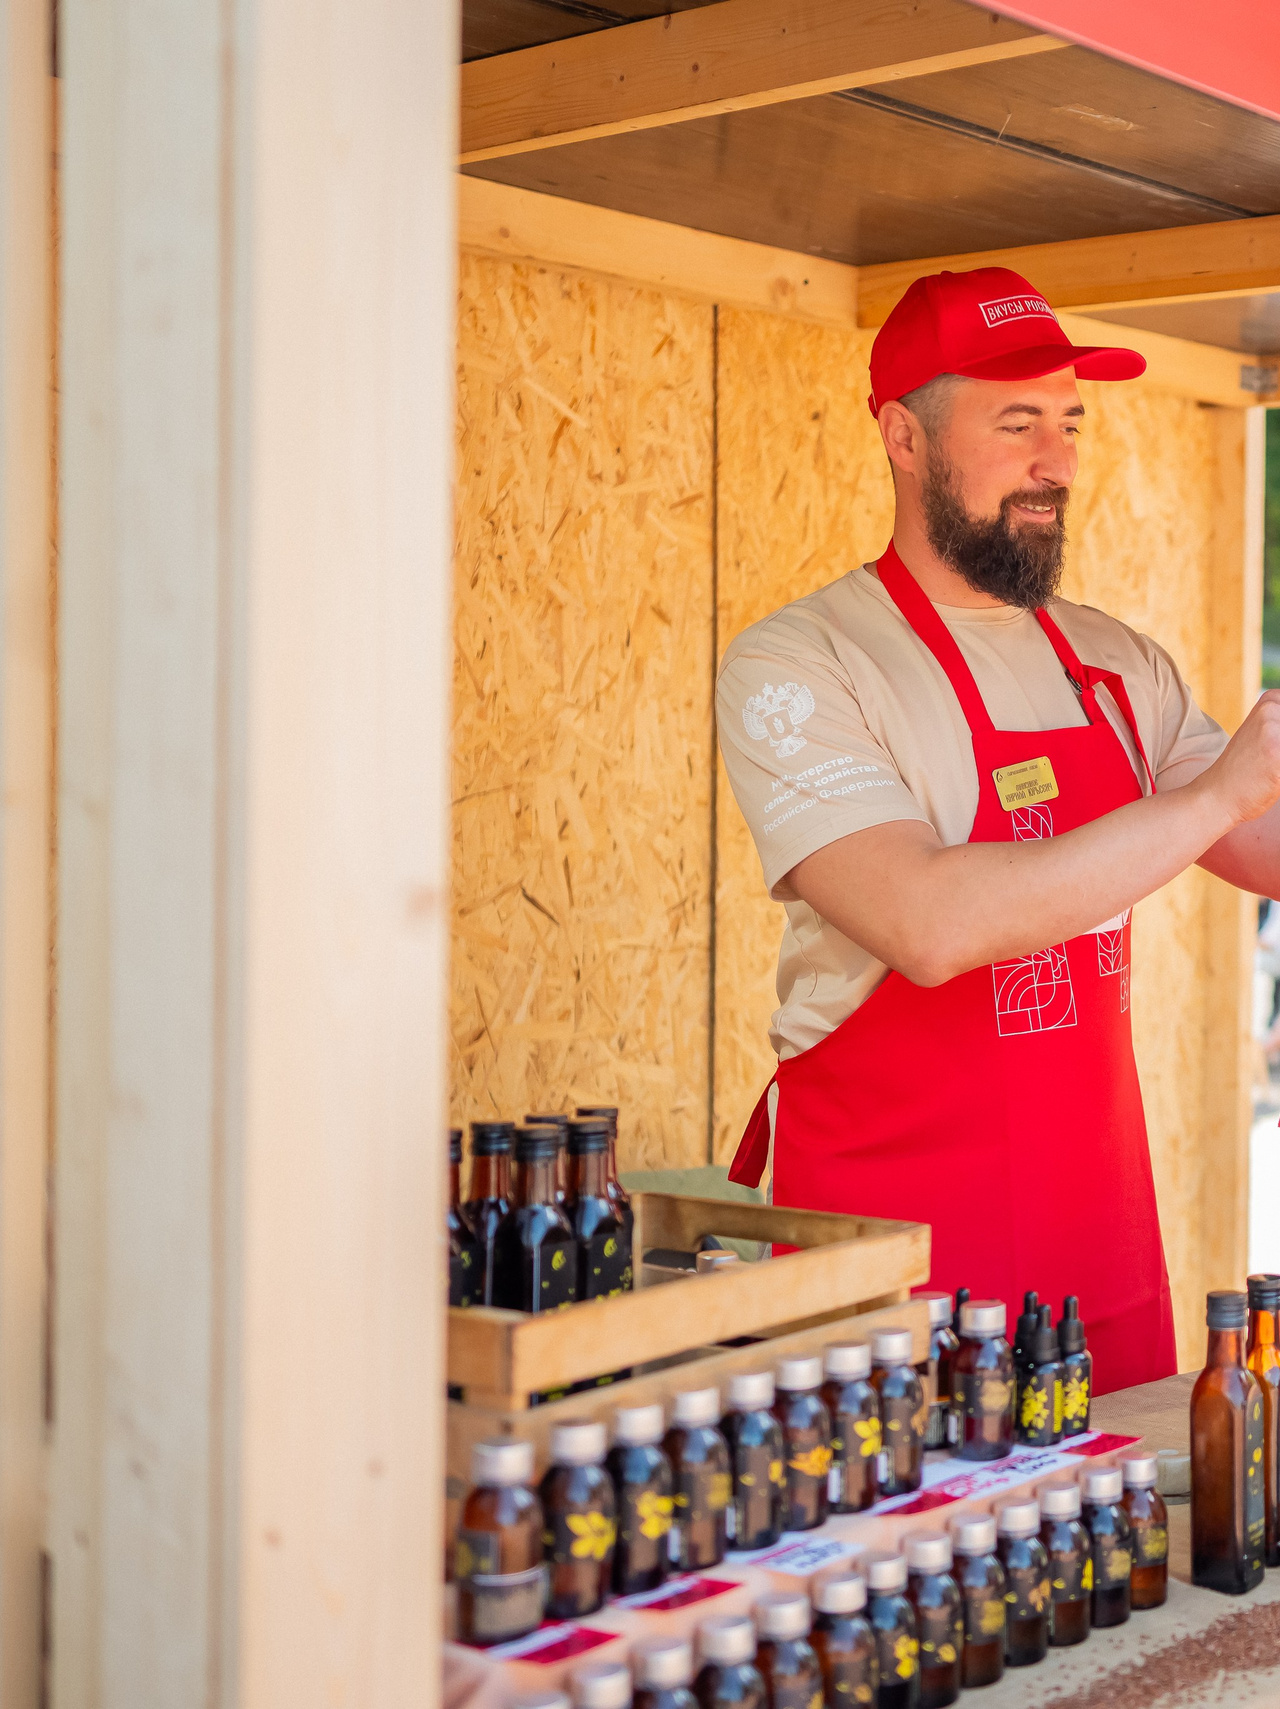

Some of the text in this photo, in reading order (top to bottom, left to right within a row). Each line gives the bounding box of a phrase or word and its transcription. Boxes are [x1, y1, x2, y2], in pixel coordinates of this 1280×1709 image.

[986, 300, 1025, 321] ВКУСЫ
[813, 765, 879, 788] хозяйства
[763, 778, 896, 836] Российской Федерации
